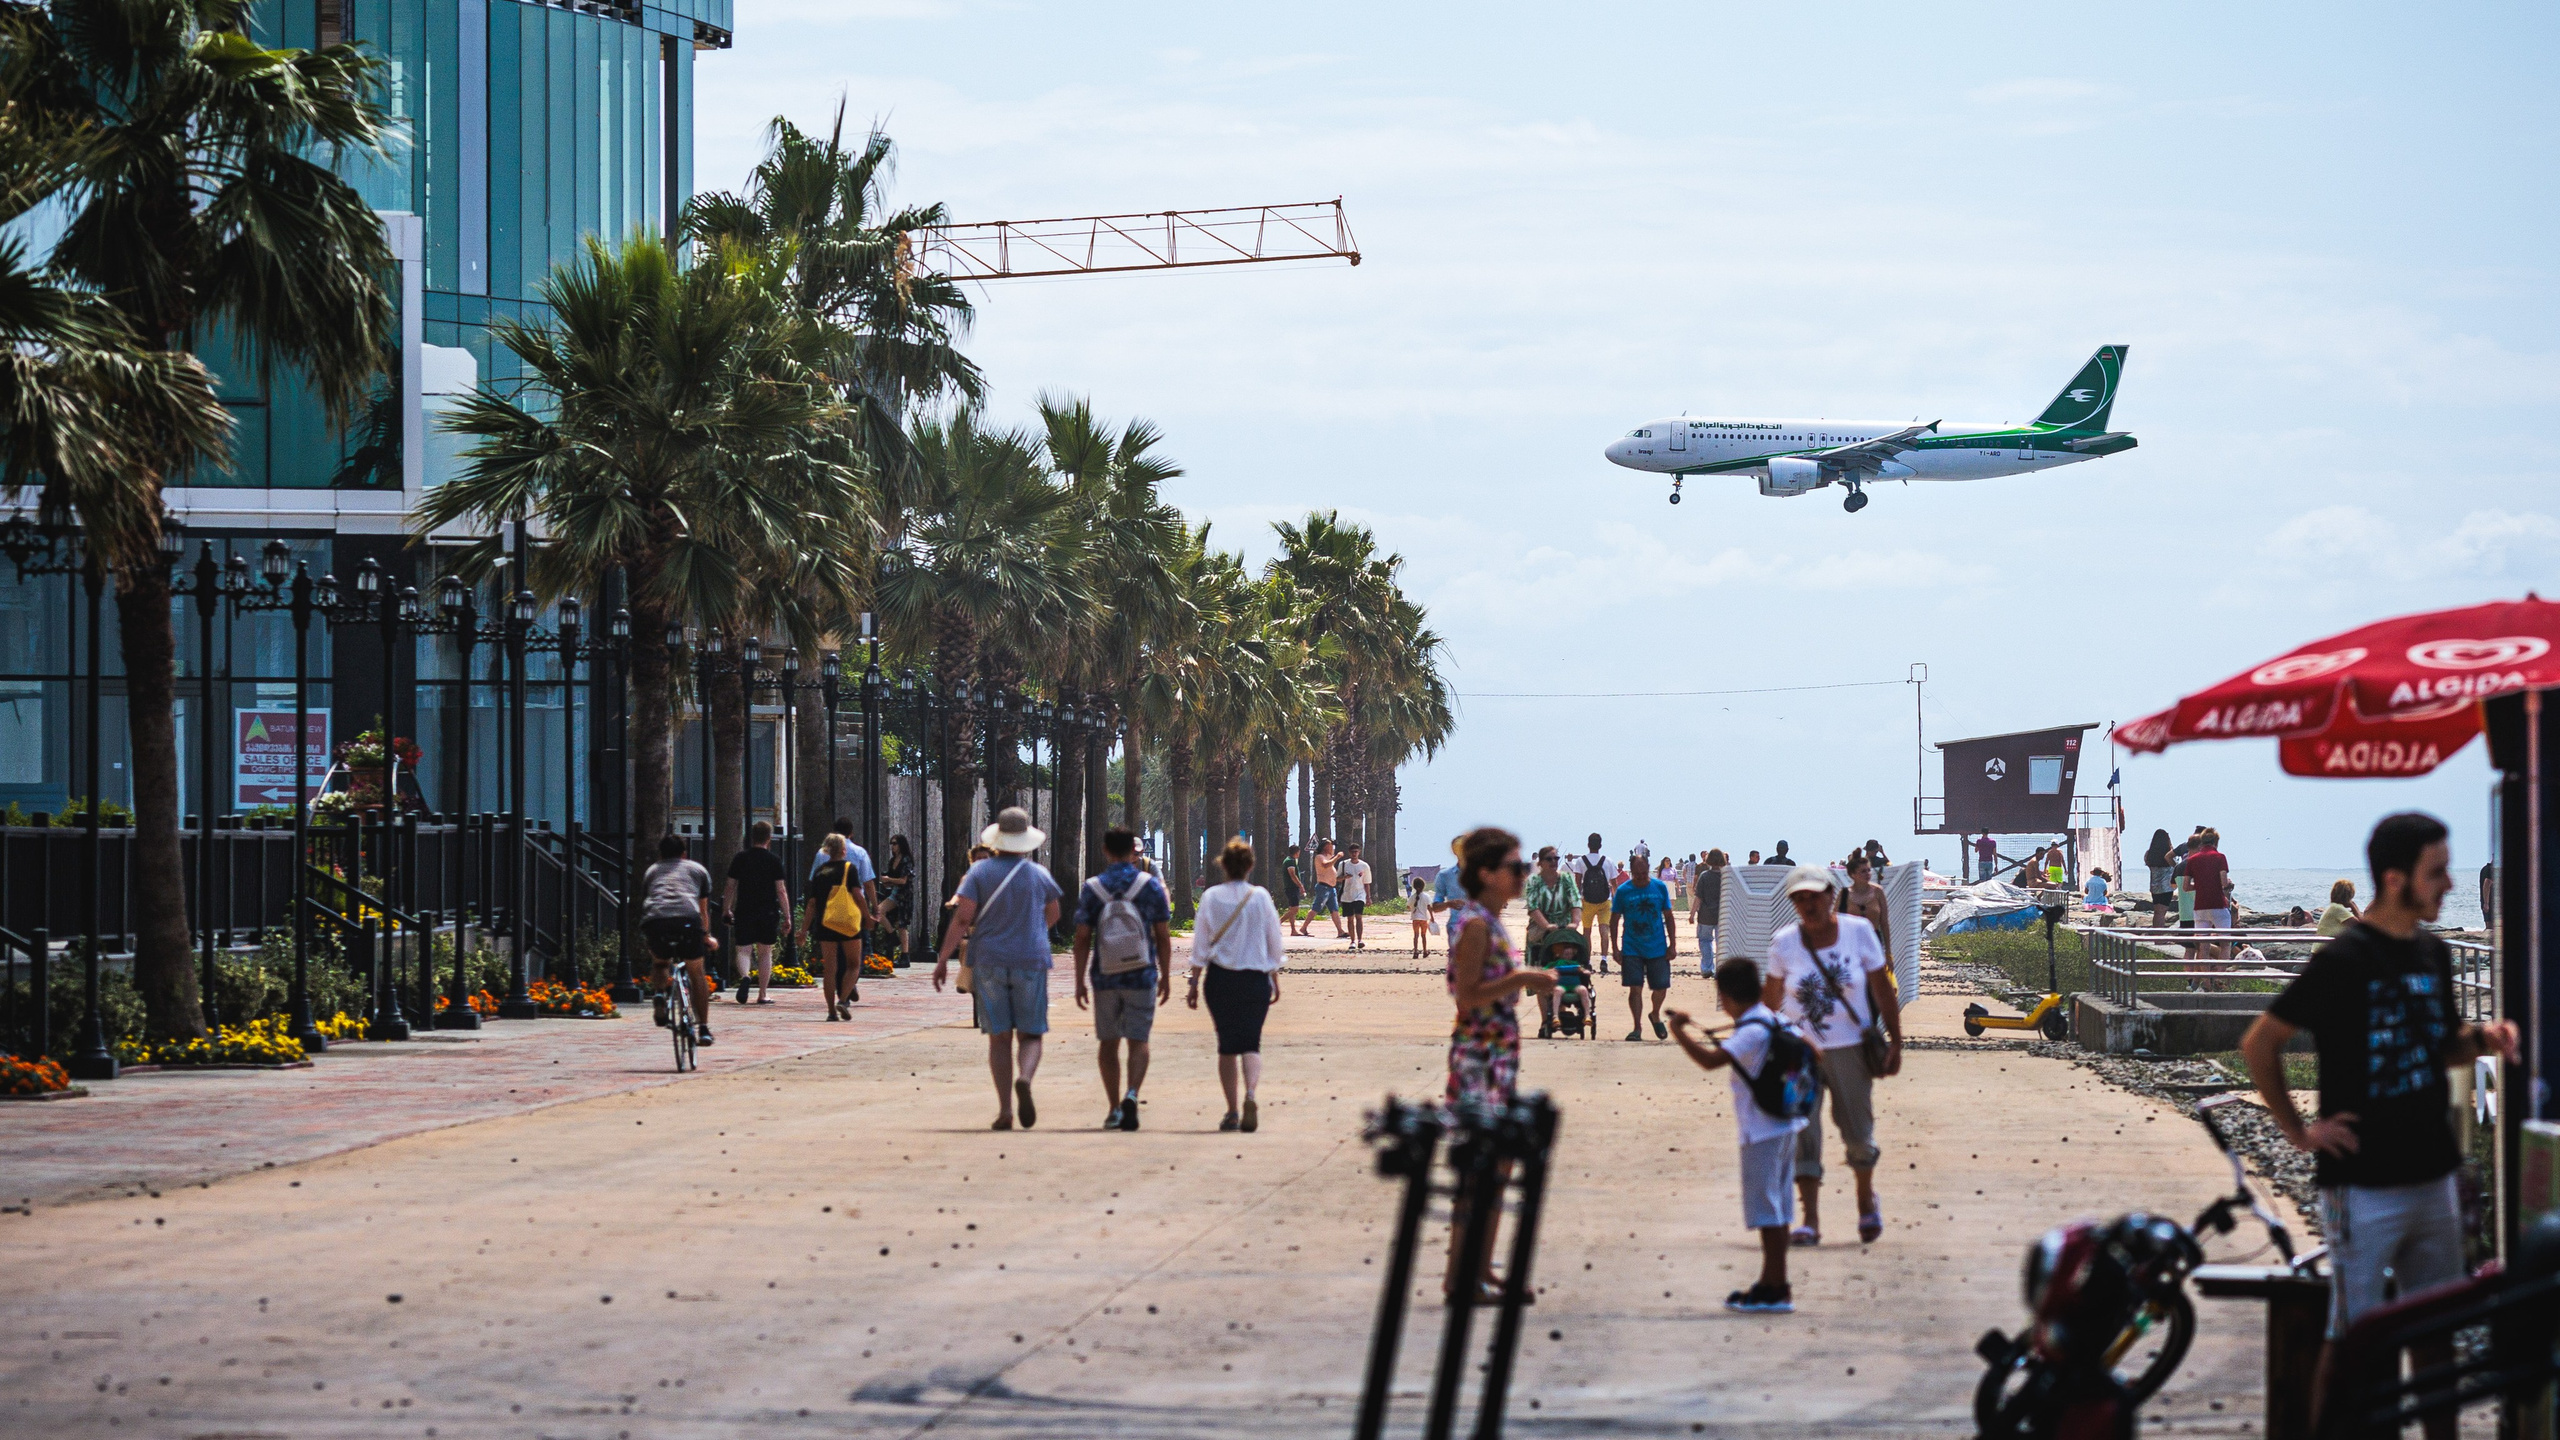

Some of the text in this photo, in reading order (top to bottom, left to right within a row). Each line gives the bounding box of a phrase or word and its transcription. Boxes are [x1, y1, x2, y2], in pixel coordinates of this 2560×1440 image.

[244, 755, 322, 766] SALES OFCE
[278, 766, 314, 774] ПРОЖ
